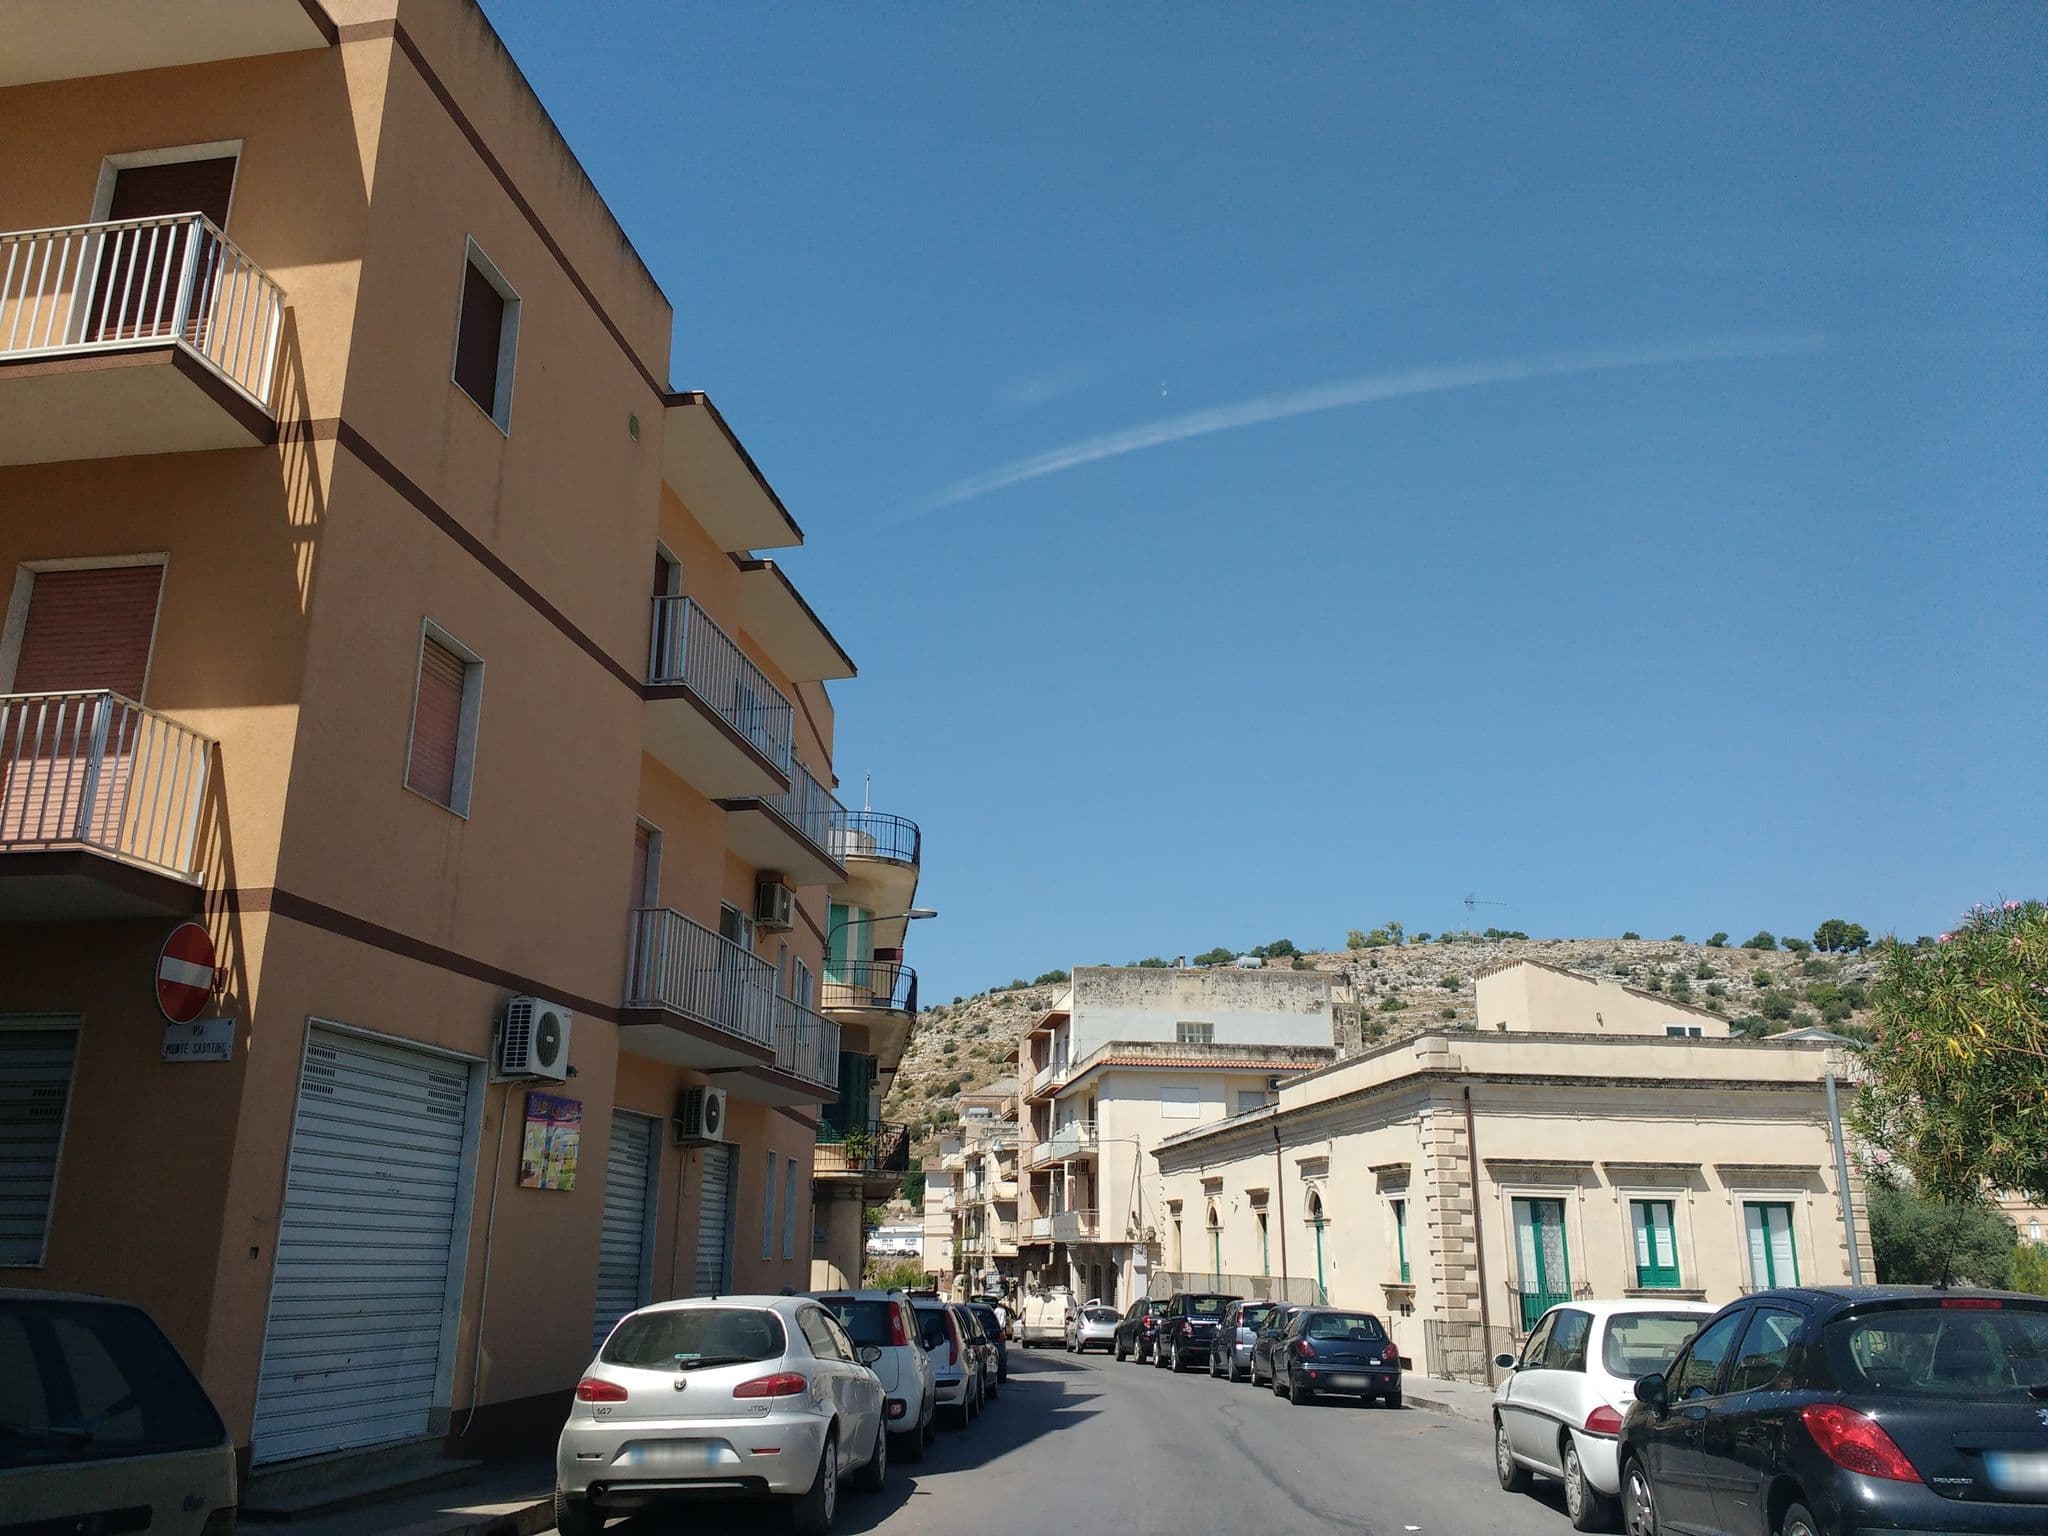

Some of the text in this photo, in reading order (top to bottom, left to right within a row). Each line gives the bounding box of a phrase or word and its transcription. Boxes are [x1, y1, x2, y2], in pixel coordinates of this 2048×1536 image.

[193, 1024, 204, 1036] VIA
[166, 1041, 190, 1055] MONTE
[597, 1407, 613, 1415] 147
